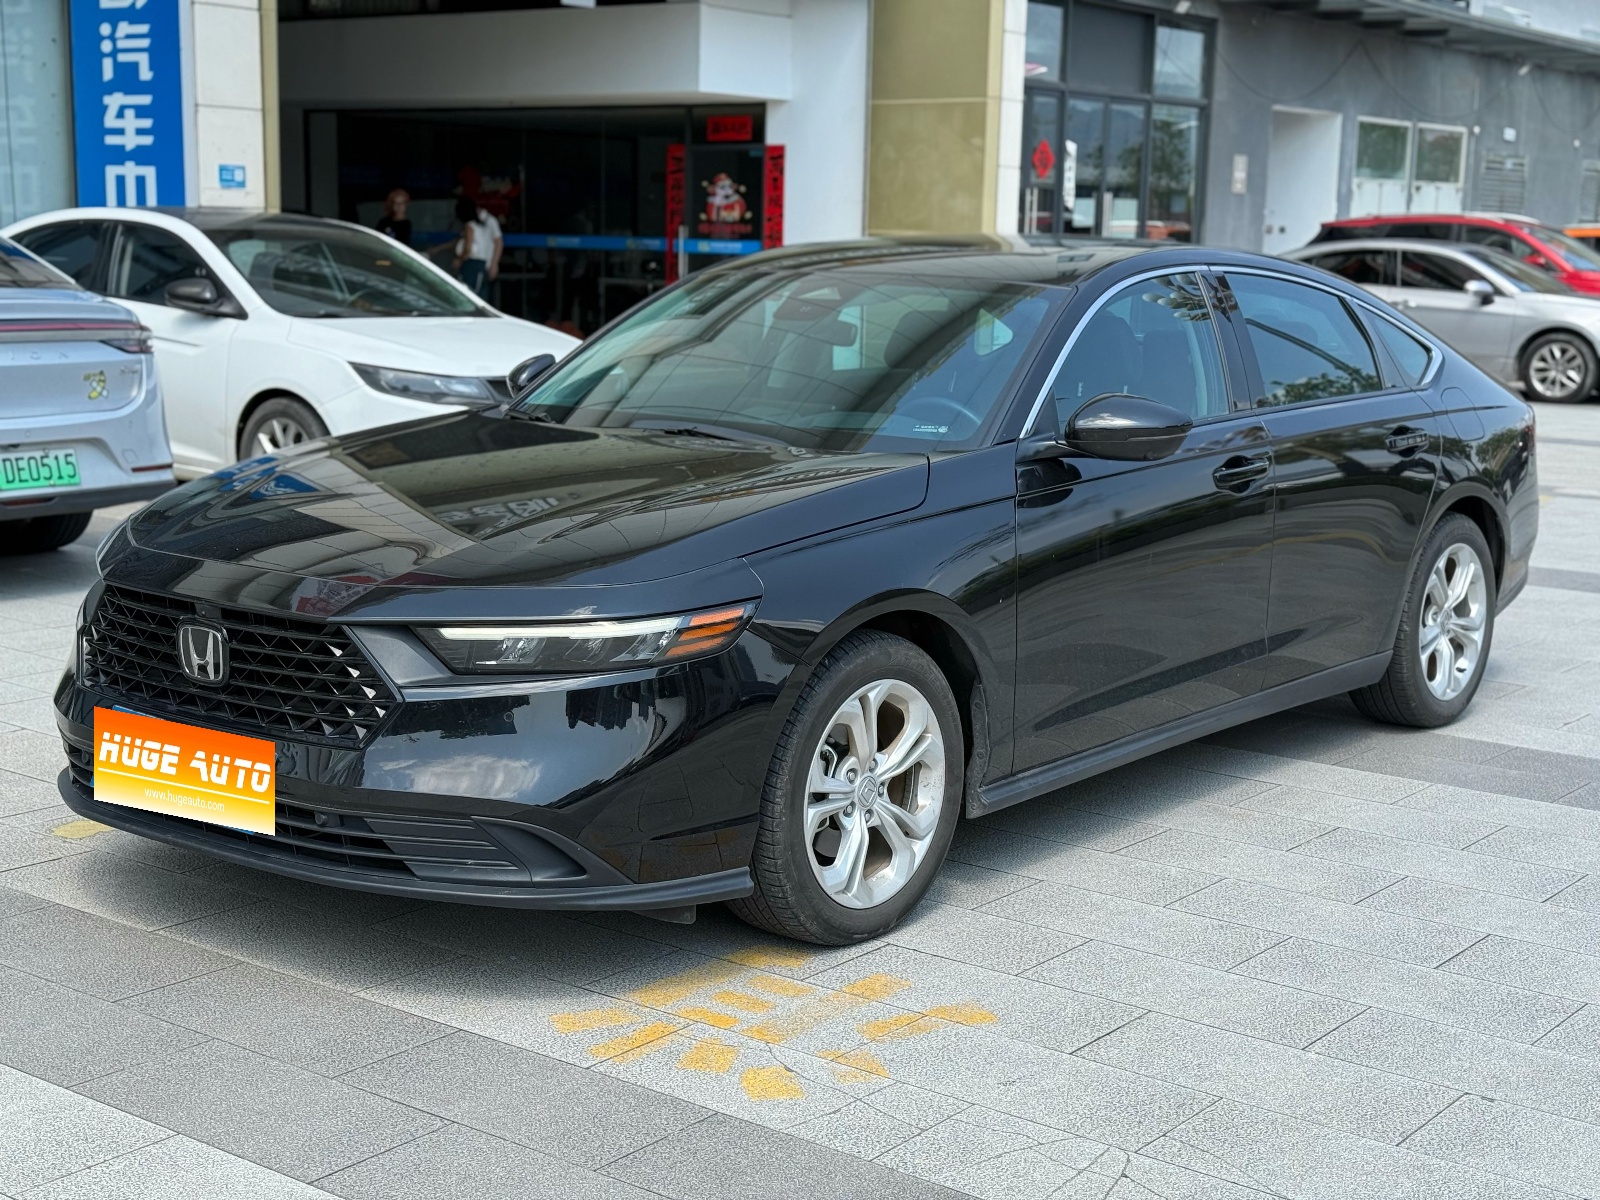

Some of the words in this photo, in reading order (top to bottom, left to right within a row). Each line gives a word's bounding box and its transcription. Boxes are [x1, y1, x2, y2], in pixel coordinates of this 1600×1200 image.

[98, 0, 157, 207] 汽车中
[2, 453, 77, 484] DE0515
